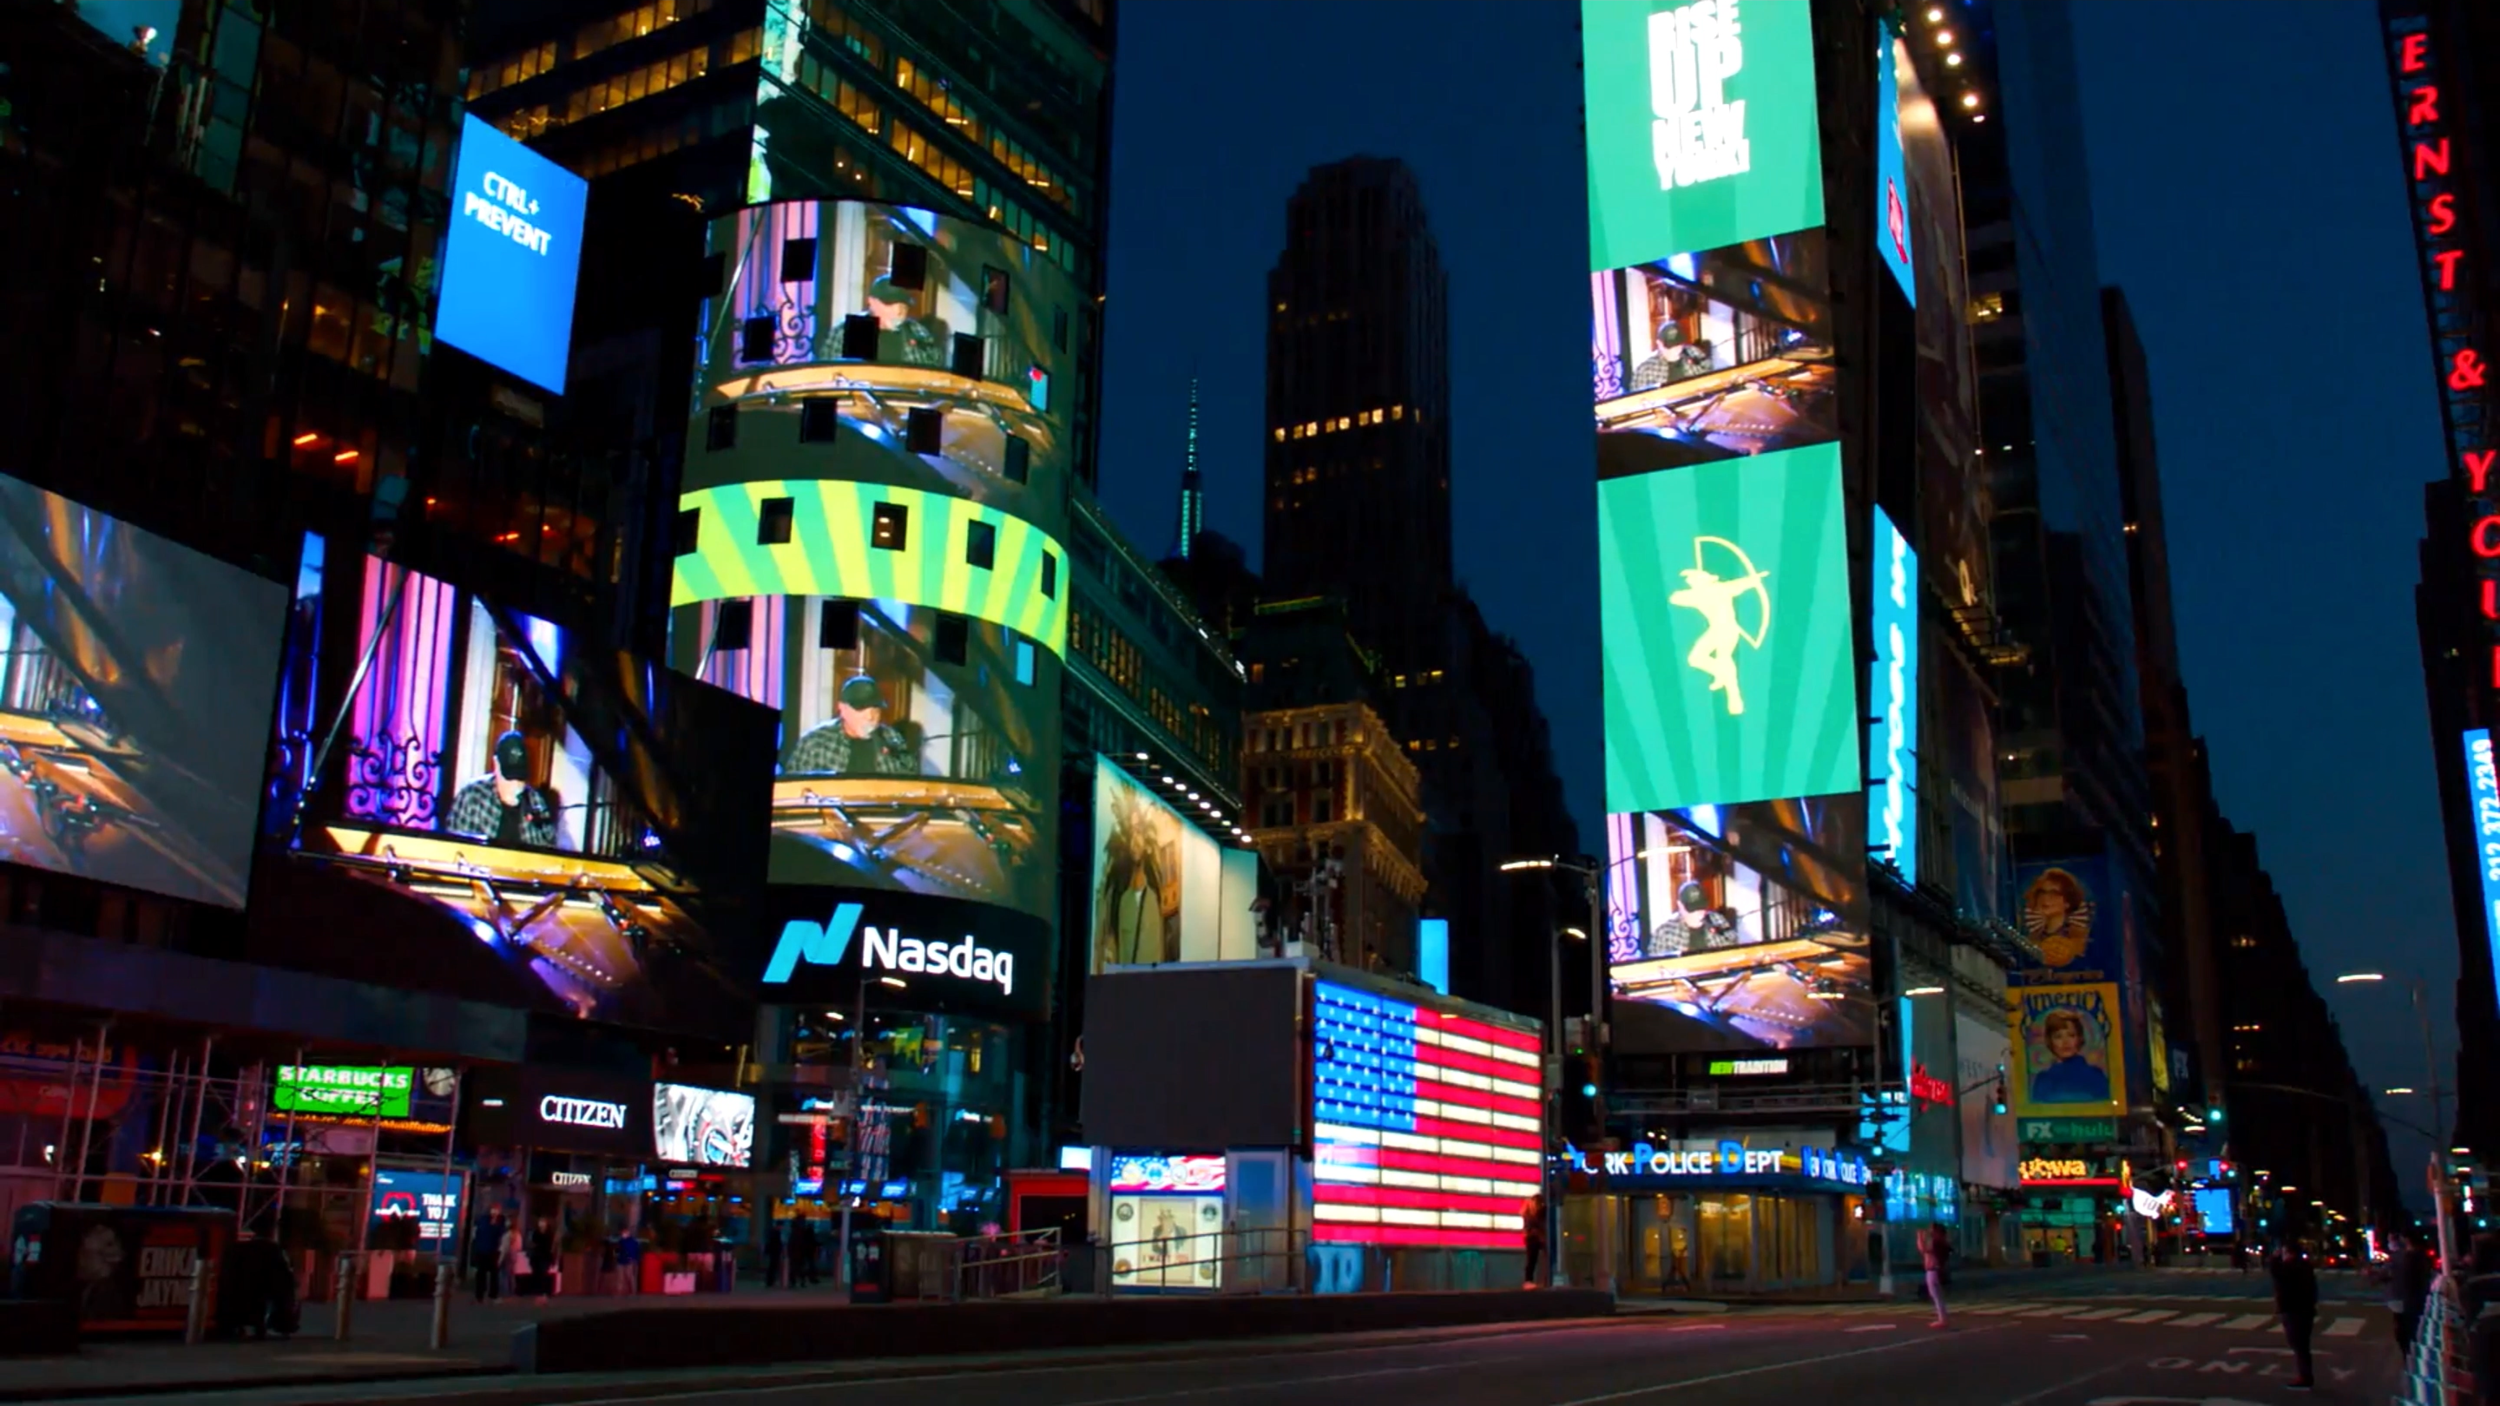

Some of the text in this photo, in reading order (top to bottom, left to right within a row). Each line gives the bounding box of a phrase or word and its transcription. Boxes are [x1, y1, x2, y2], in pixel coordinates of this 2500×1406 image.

[1649, 36, 1743, 118] UP
[1652, 99, 1746, 157] NEW
[484, 171, 540, 215] CTRL+
[2401, 32, 2464, 291] ERNST
[2446, 348, 2488, 391] &
[464, 191, 552, 256] PREVENT
[863, 926, 1013, 996] Nasdaq
[280, 1066, 409, 1089] STARBUCKS
[540, 1095, 627, 1129] CITIZEN
[1633, 1141, 1712, 1176] POLICE
[1718, 1139, 1784, 1176] DEPT
